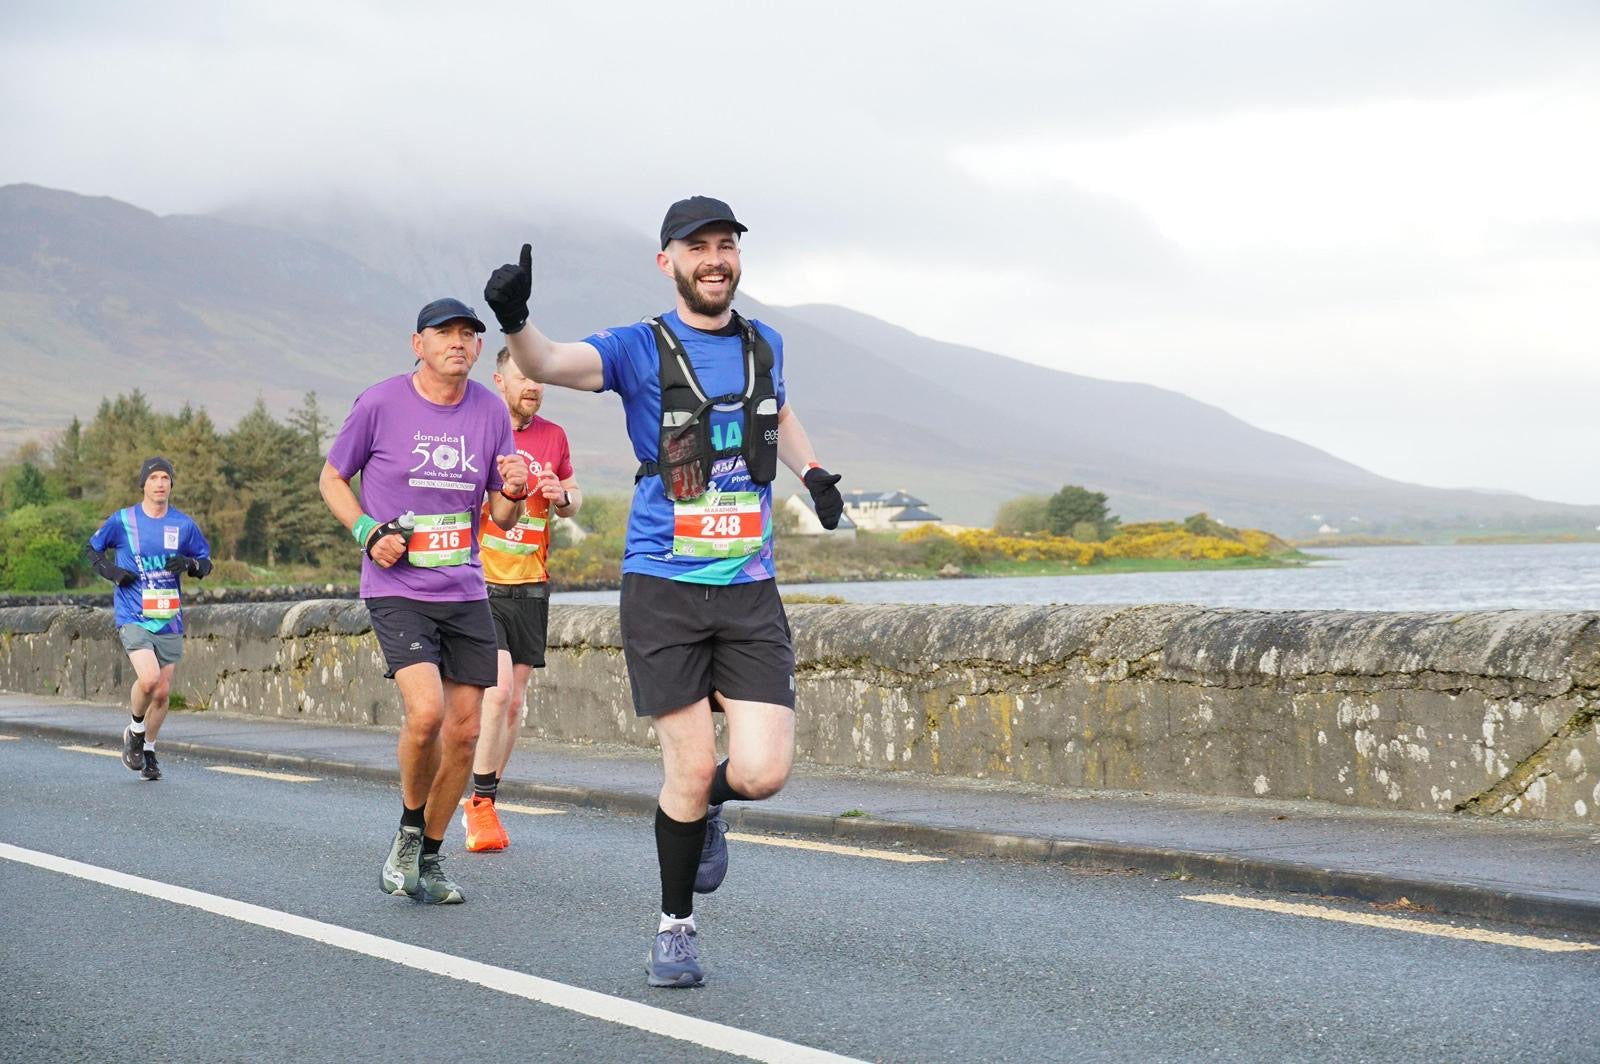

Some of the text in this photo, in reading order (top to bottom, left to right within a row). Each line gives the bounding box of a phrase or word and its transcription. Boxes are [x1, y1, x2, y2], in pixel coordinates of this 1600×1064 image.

[413, 430, 459, 443] donadea
[701, 515, 741, 536] 248
[428, 532, 460, 549] 216
[157, 600, 170, 609] 89
